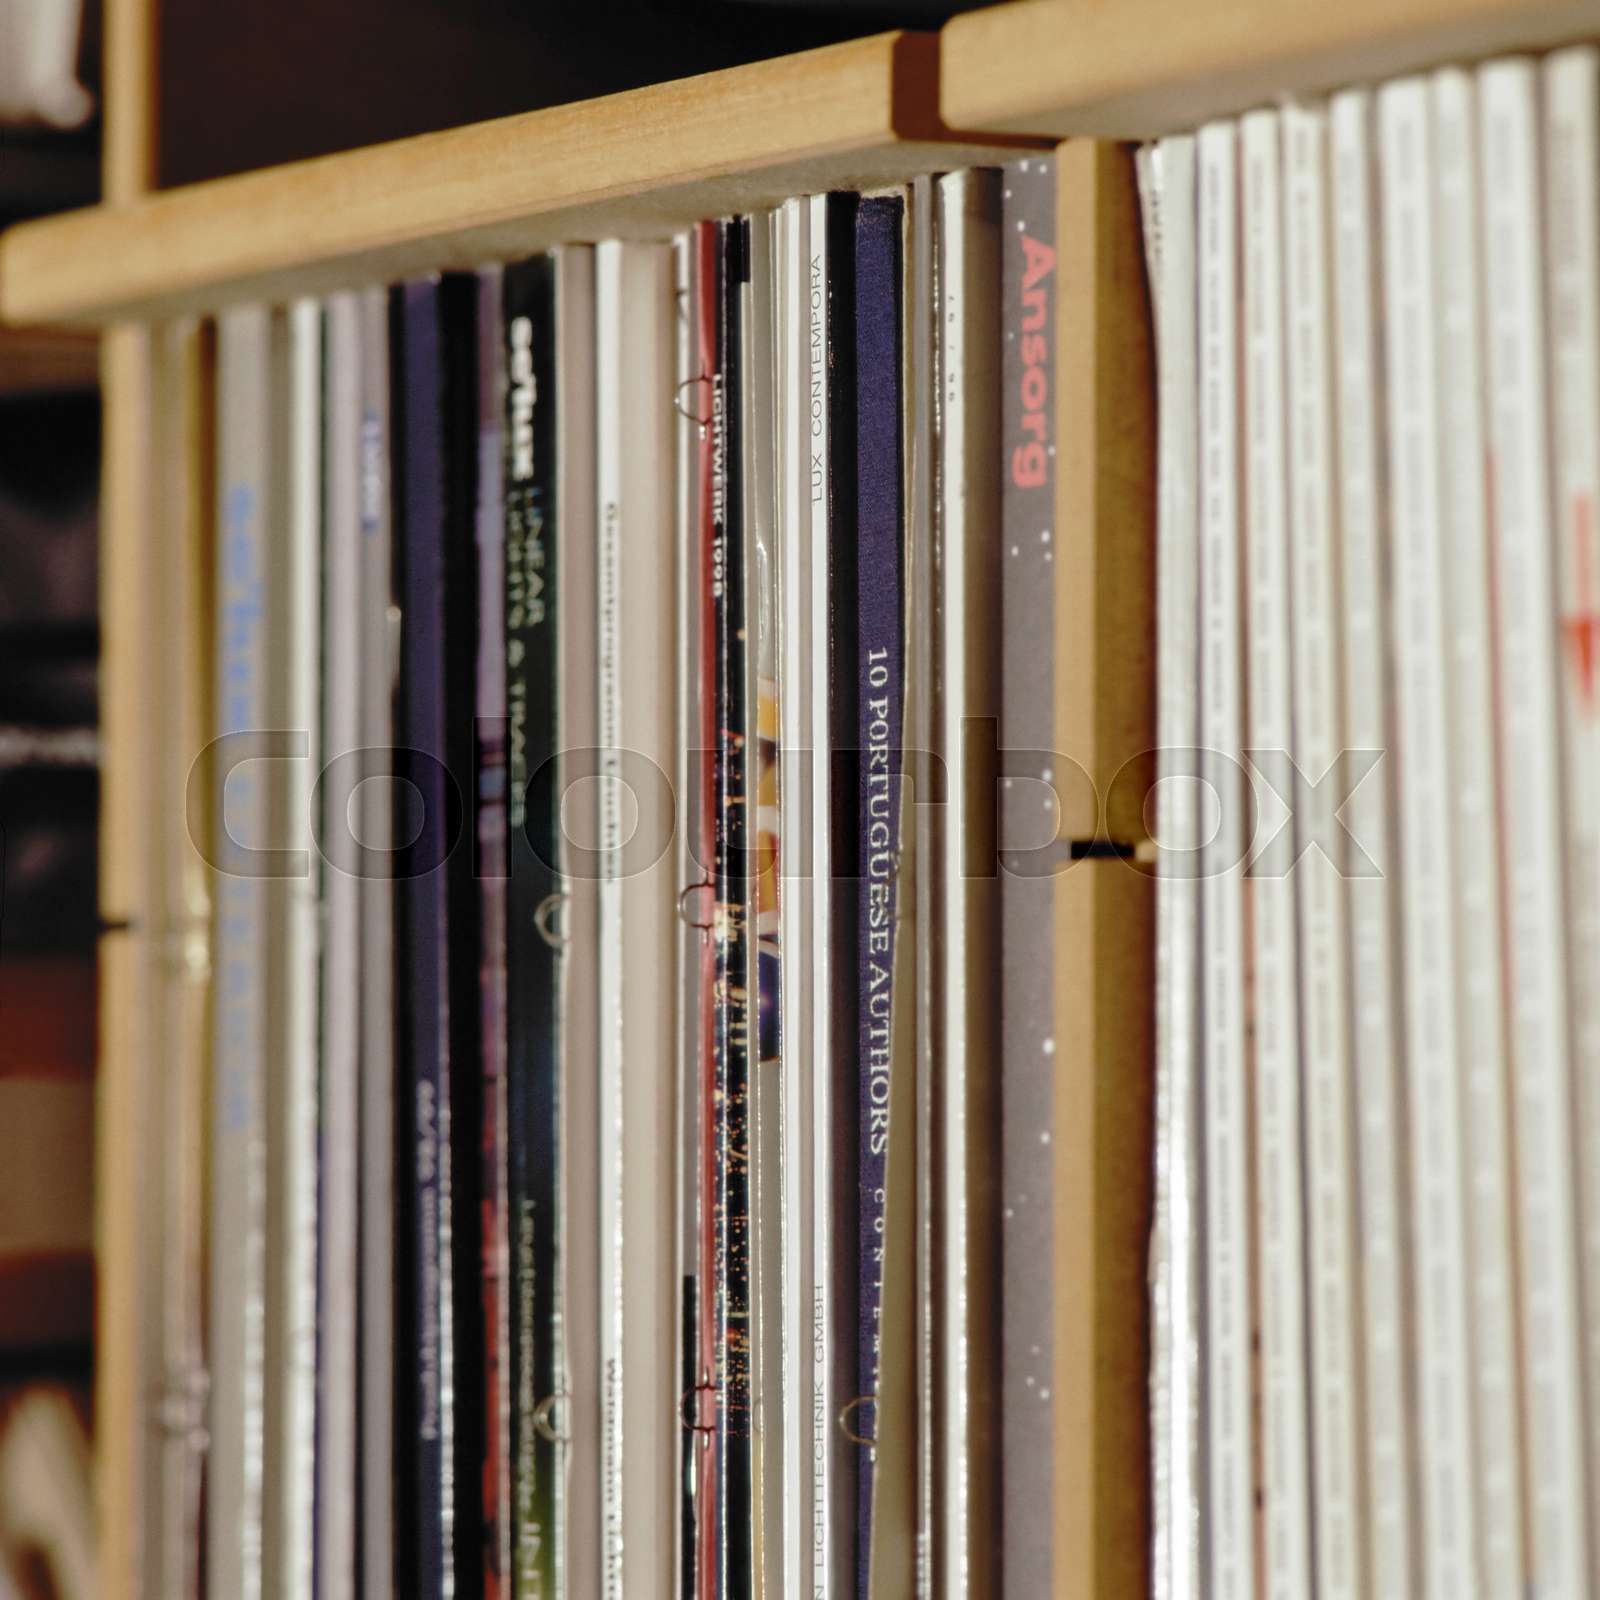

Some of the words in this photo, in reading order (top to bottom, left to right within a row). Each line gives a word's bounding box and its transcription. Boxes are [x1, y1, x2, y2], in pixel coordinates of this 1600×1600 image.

[810, 254, 823, 438] CONTEMPORA
[1012, 236, 1057, 488] Ansorg
[711, 536, 723, 598] 1998
[811, 453, 823, 503] LUX
[869, 647, 888, 686] 10
[869, 697, 890, 953] PORTUGUESE
[868, 962, 890, 1155] AUTHORS
[813, 1285, 824, 1364] GMBH
[813, 1380, 824, 1567] LICHTTECHNIK
